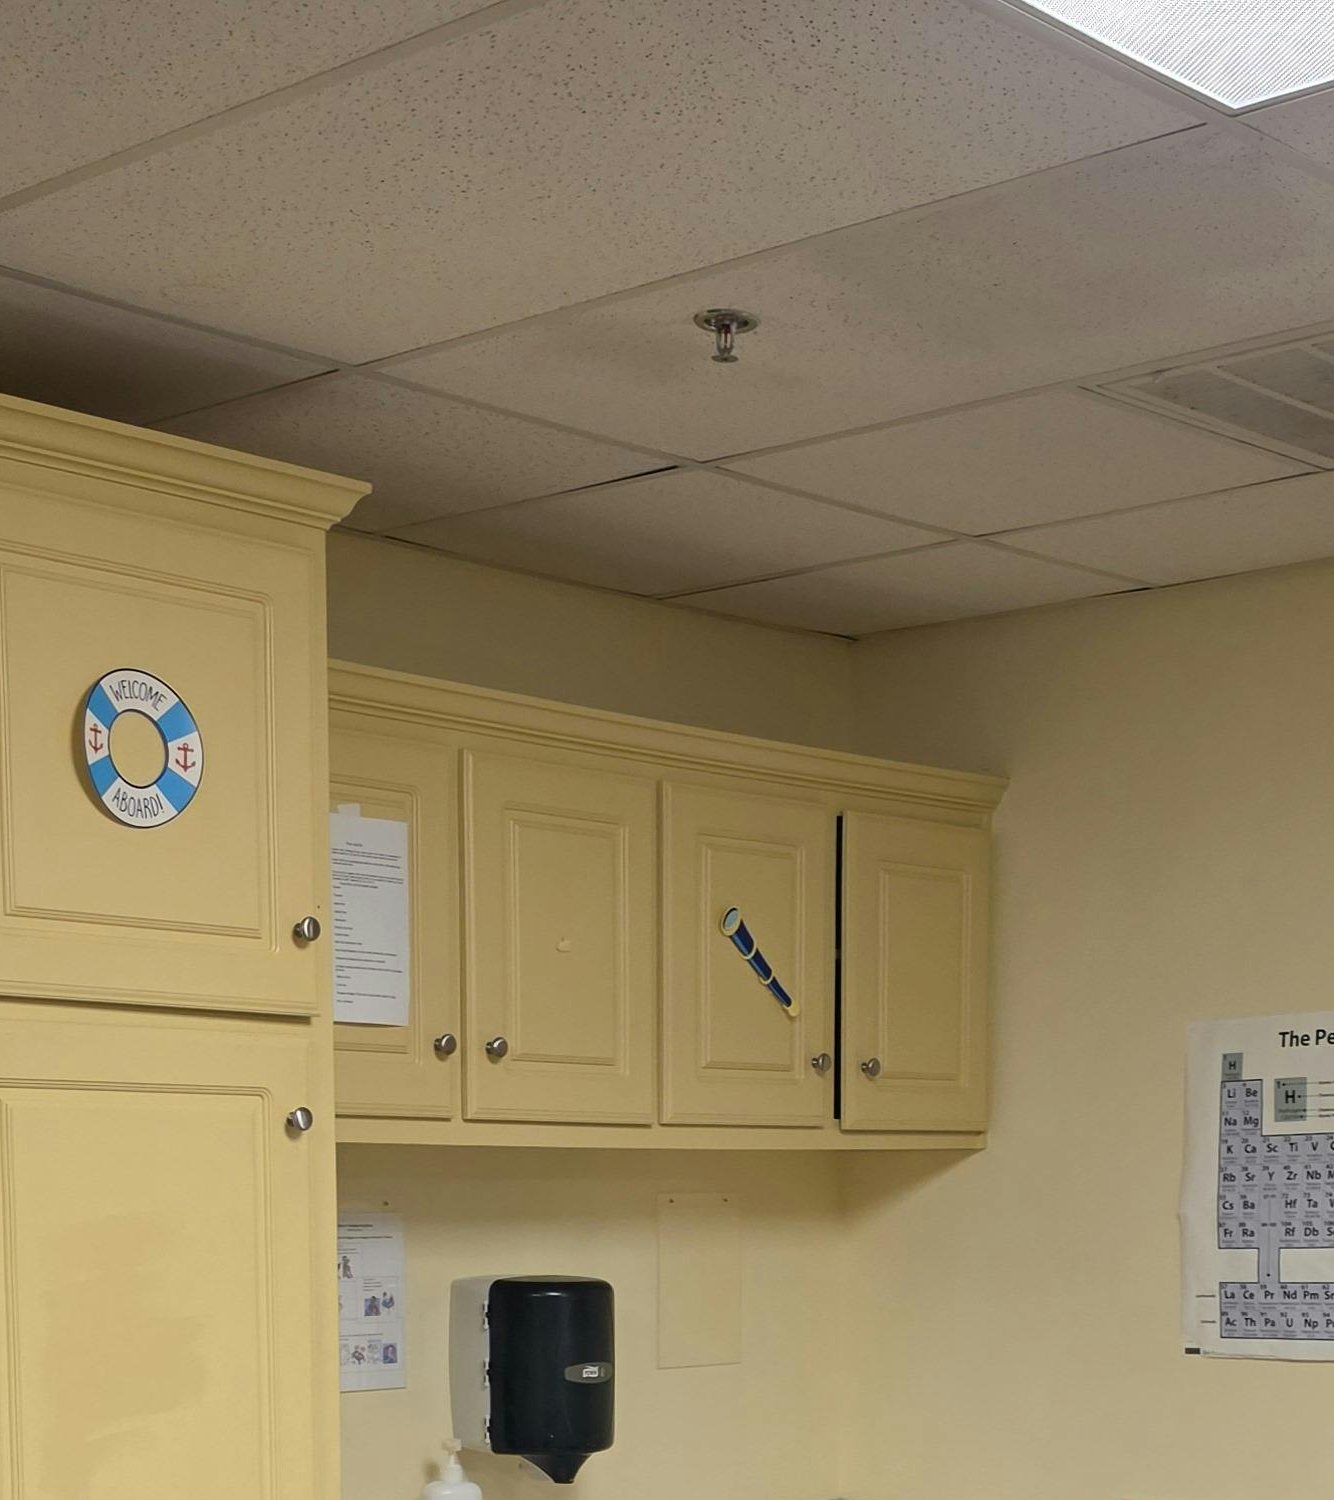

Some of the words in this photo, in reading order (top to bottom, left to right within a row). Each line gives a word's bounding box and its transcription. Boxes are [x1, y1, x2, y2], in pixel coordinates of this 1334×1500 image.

[109, 680, 167, 711] WELCOME
[112, 788, 165, 819] ABOARD!
[1278, 1030, 1310, 1048] The
[1228, 1089, 1235, 1098] Li
[1246, 1088, 1258, 1097] Be
[1285, 1090, 1296, 1103] H
[1224, 1117, 1237, 1126] Na
[1244, 1117, 1259, 1127] Mg
[1307, 1171, 1321, 1179] Nb
[1285, 1200, 1296, 1208] Hf
[1304, 1228, 1318, 1236] Db
[1284, 1291, 1296, 1299] Nd
